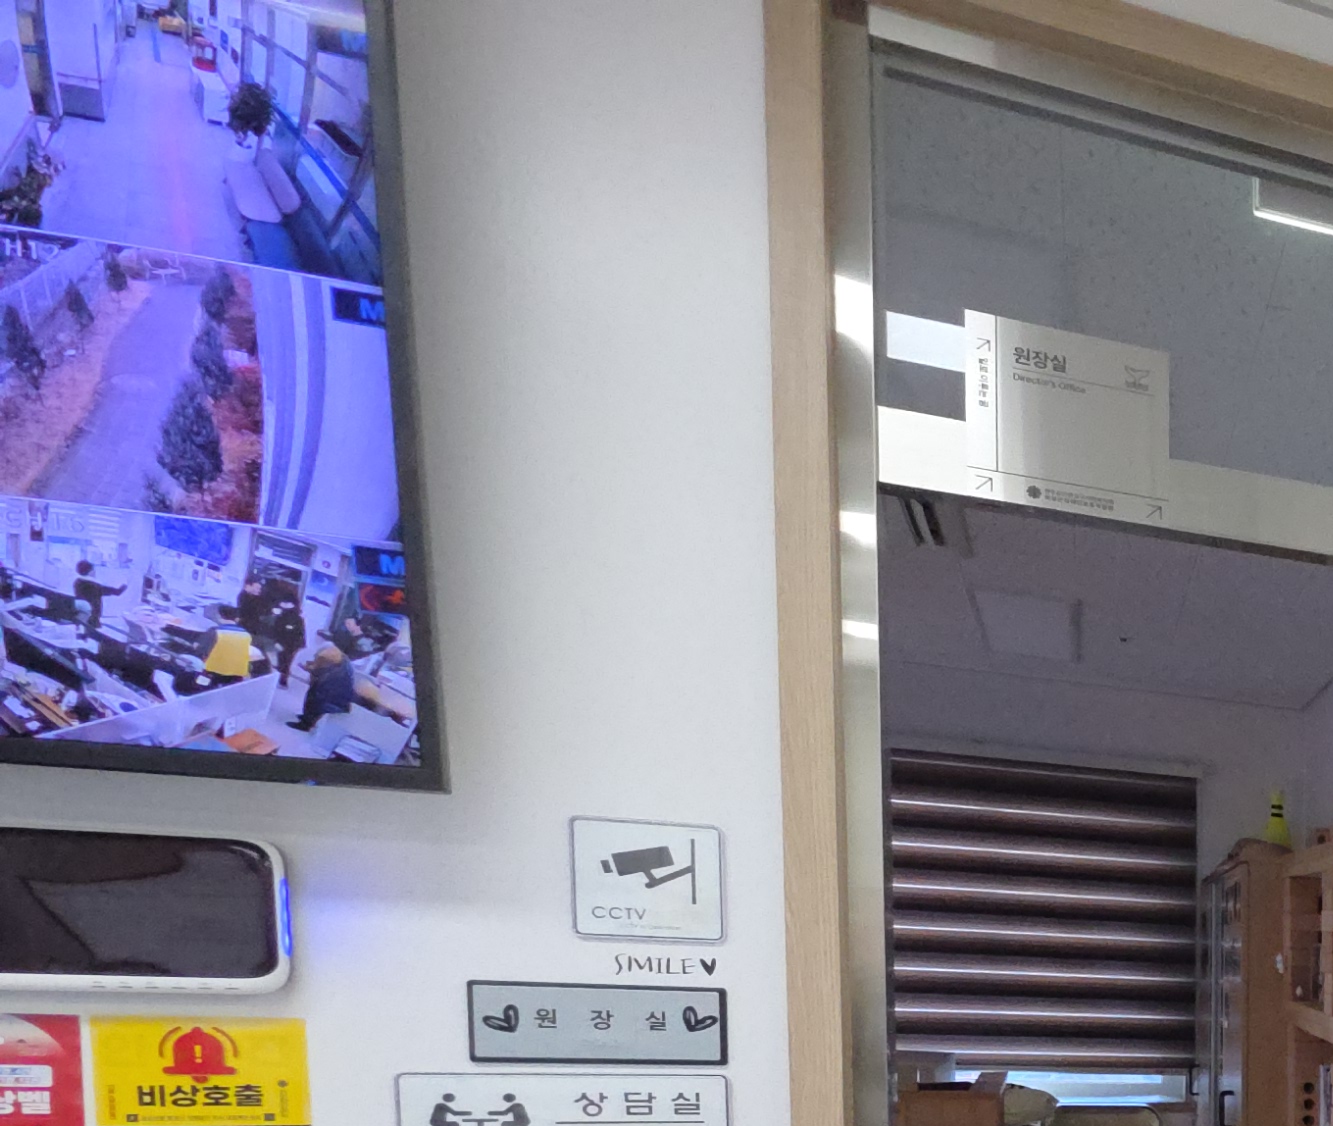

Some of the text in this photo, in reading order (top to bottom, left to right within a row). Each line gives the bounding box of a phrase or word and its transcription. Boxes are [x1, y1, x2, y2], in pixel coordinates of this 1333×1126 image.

[1013, 346, 1067, 373] 원장실
[591, 906, 646, 920] CCTV
[615, 953, 696, 976] SMILE
[136, 1084, 263, 1107] 비상호출
